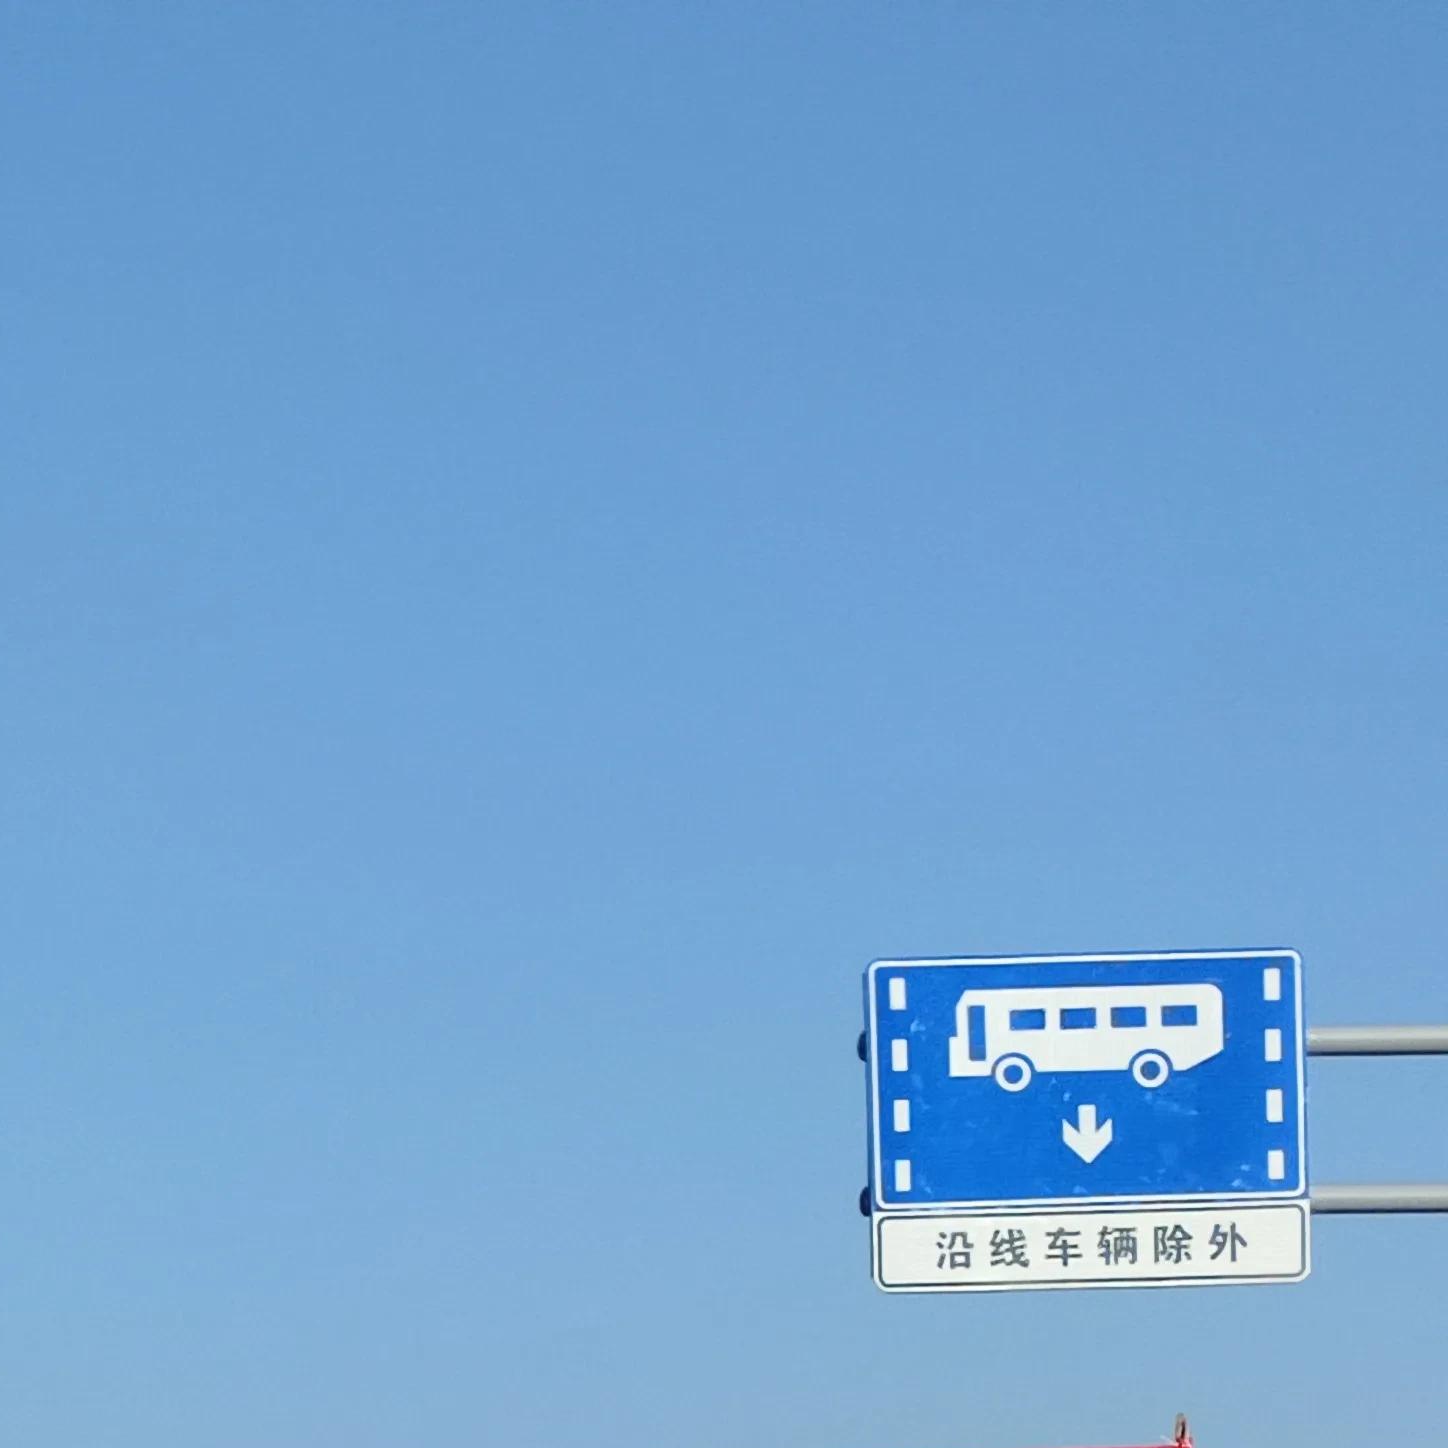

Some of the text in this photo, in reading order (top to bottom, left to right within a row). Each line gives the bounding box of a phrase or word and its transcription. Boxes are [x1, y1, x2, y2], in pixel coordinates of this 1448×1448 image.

[935, 1222, 1248, 1271] 沿线车辆除外
